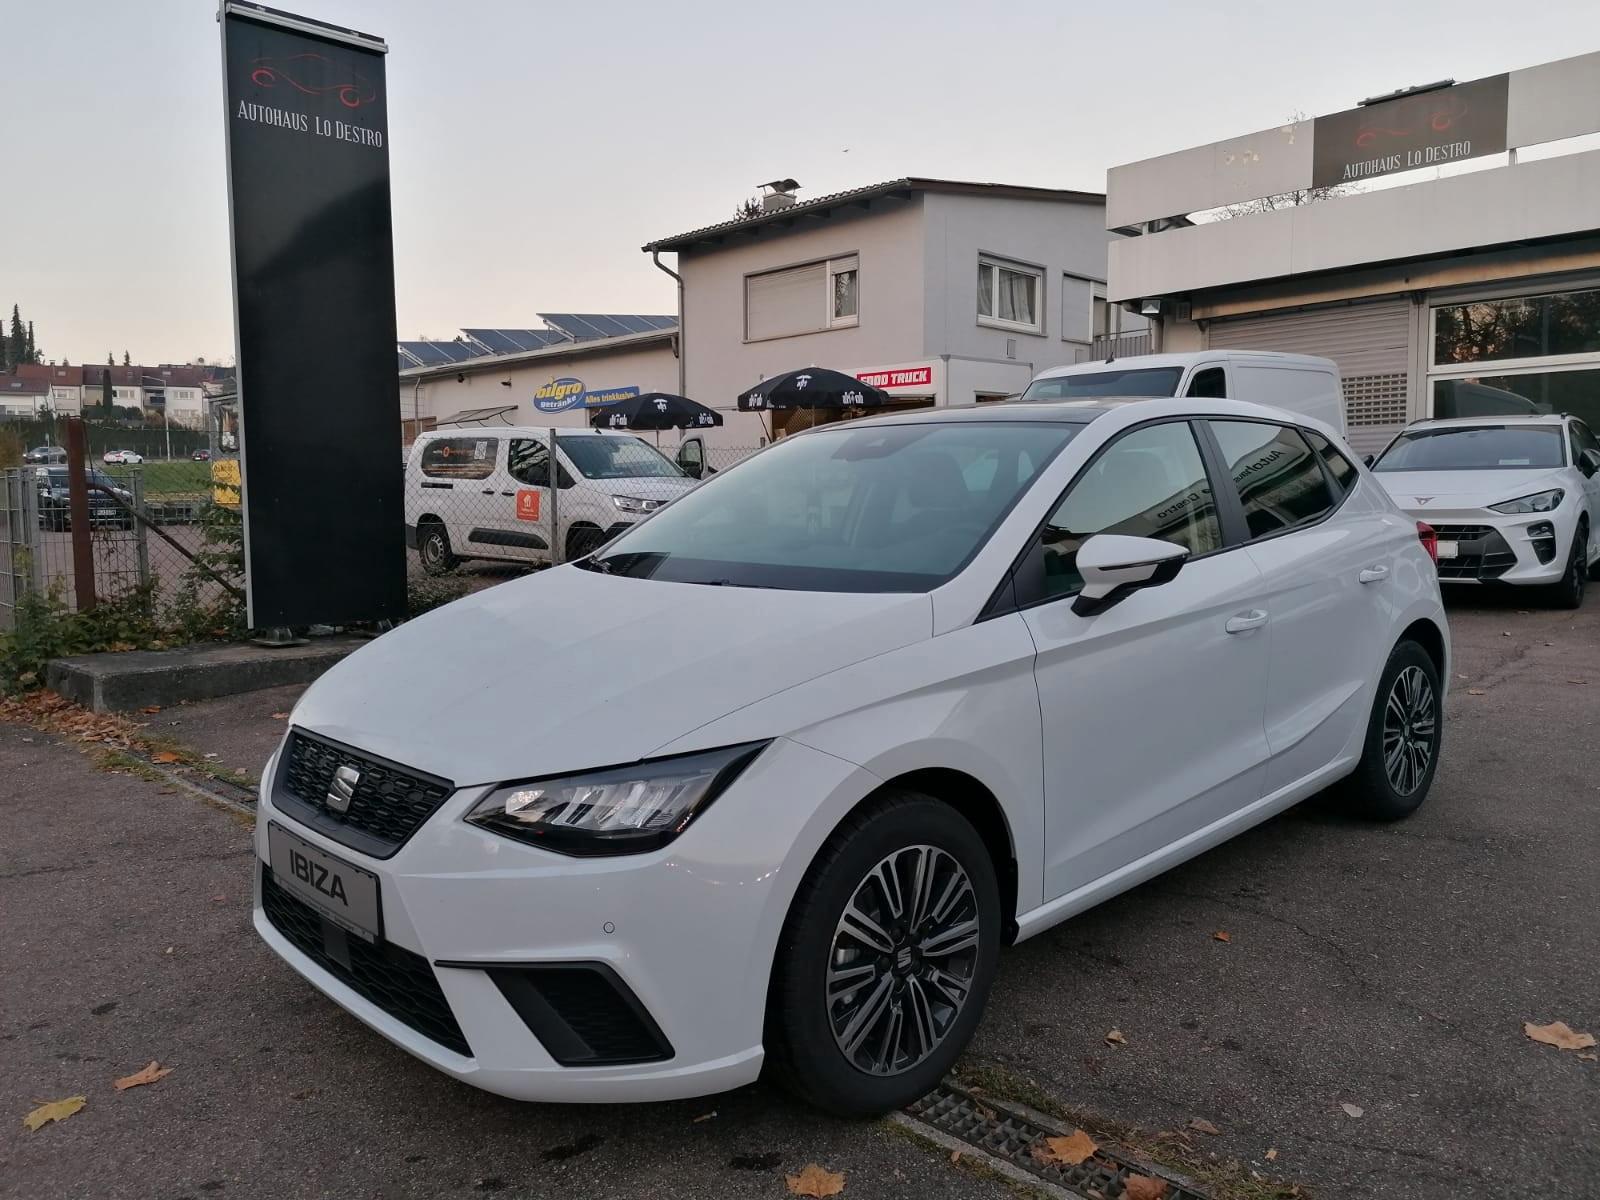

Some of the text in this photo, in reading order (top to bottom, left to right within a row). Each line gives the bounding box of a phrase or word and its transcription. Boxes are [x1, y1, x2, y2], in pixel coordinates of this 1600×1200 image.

[237, 100, 383, 148] AUTOHAUS LO DESTRO
[1343, 140, 1471, 180] AUTOHAUS LO DESTRO
[891, 370, 927, 385] TRUCK
[289, 848, 349, 907] IBIZA
